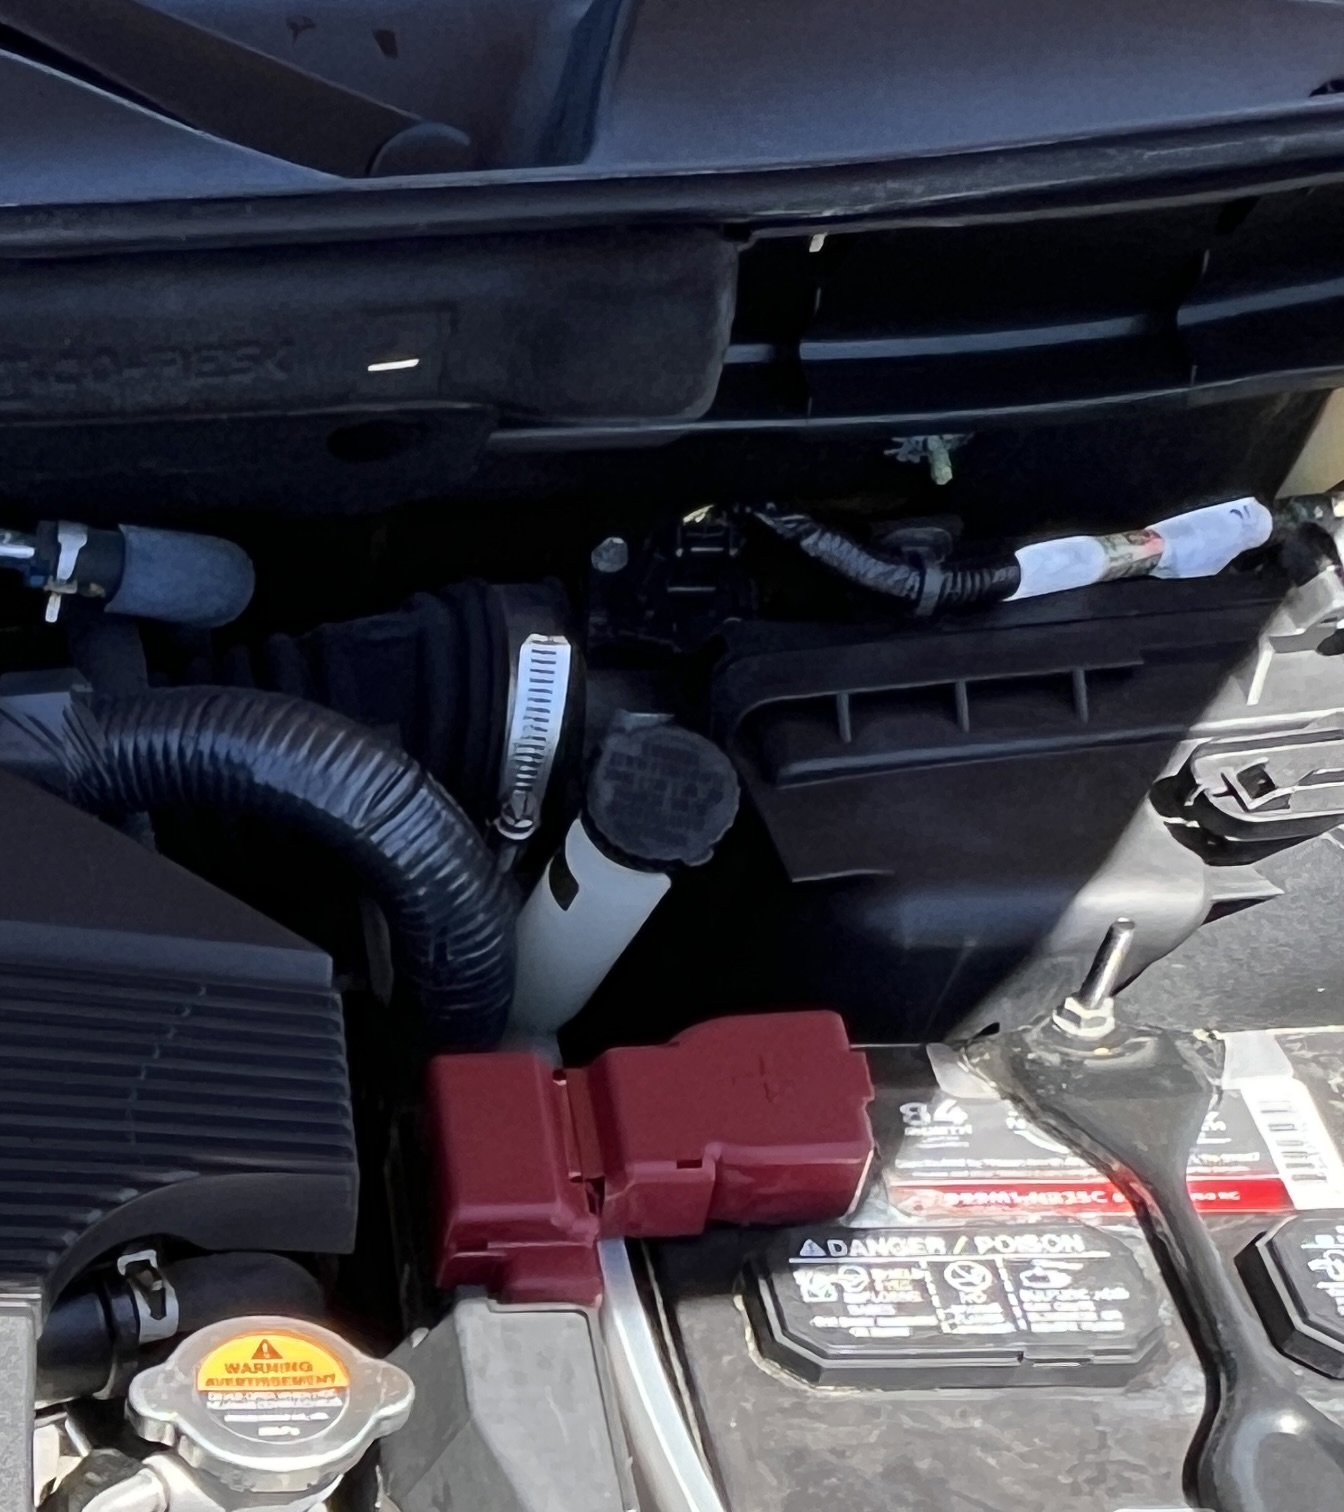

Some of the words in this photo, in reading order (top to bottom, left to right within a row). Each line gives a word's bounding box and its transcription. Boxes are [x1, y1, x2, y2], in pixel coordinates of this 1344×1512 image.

[827, 1236, 947, 1256] DANGER
[974, 1234, 1086, 1255] POISON
[224, 1361, 314, 1374] WARNING
